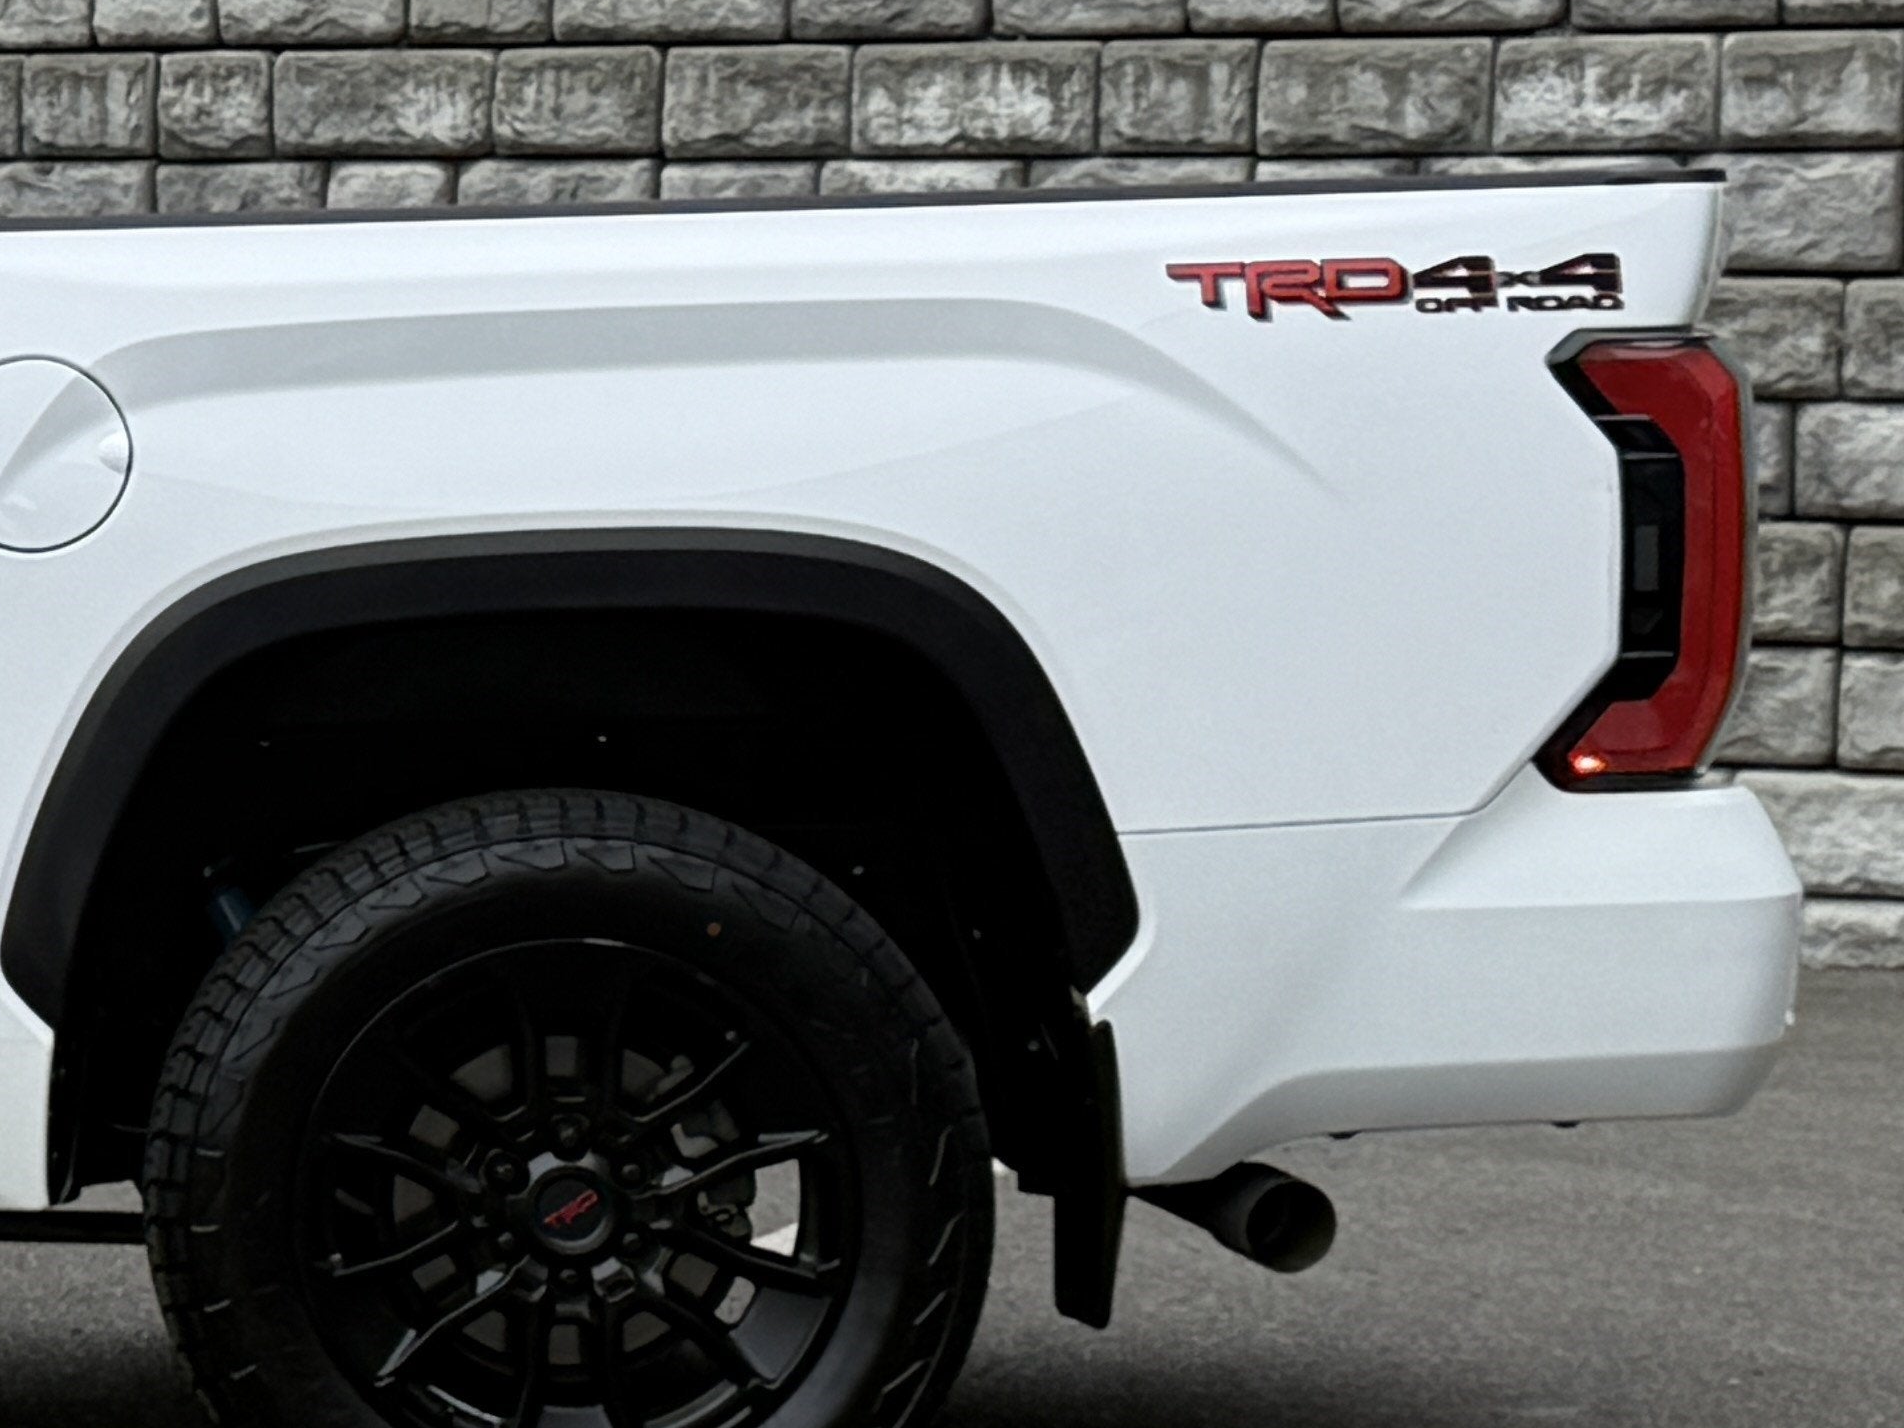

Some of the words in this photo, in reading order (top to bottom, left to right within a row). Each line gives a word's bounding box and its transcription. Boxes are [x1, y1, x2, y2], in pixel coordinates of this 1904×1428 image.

[1166, 257, 1411, 321] TRD
[1415, 296, 1499, 314] OFF
[1507, 295, 1625, 312] ROAD
